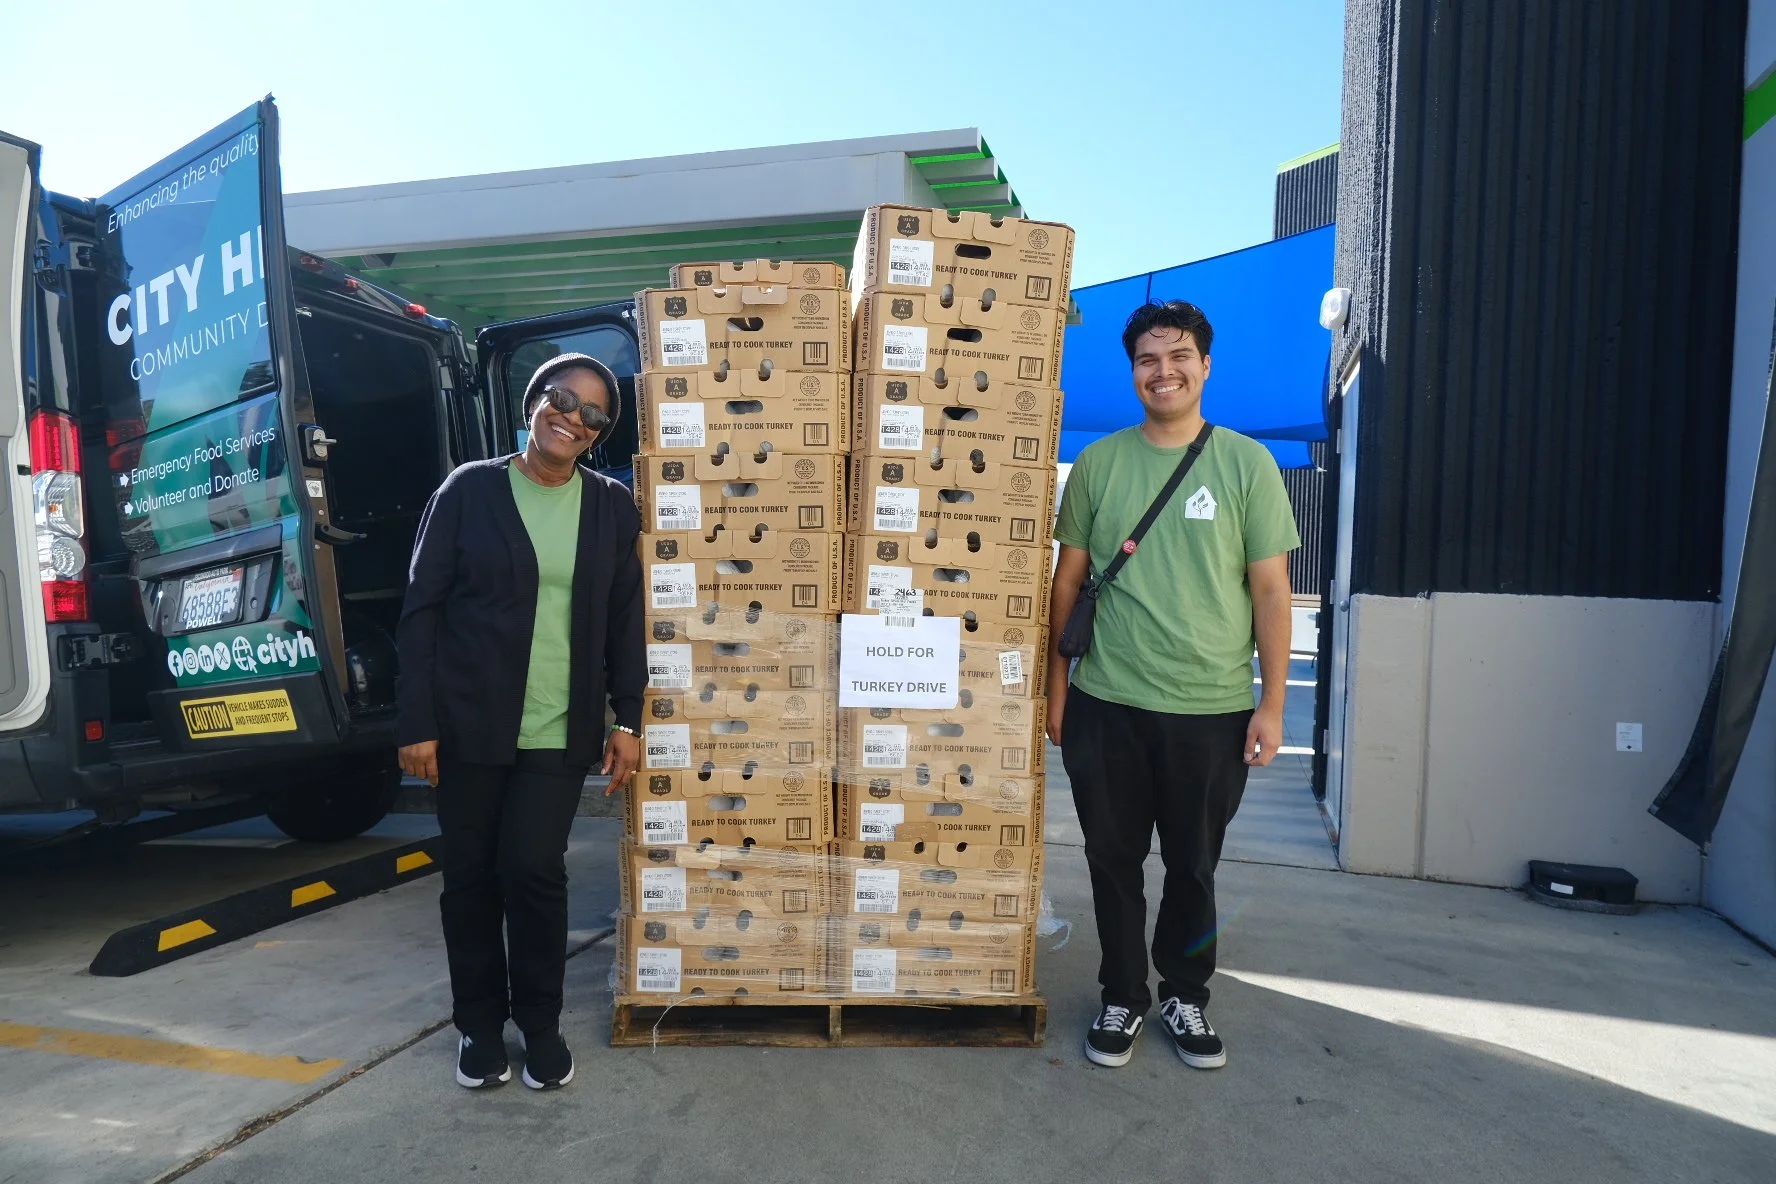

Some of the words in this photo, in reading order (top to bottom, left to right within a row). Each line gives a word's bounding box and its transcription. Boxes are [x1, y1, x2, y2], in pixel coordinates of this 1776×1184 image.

[107, 180, 179, 234] Enhancing
[183, 167, 206, 190] the
[210, 132, 259, 176] quality
[935, 264, 957, 274] READY
[959, 266, 969, 274] TO
[970, 267, 989, 277] COOK
[990, 270, 1018, 281] TURKEY
[107, 254, 205, 346] CITY
[130, 308, 250, 380] COMMUNITY
[710, 341, 730, 349] READY
[929, 348, 950, 357] READY
[951, 348, 960, 356] TO
[962, 349, 981, 358] COOK
[983, 352, 1010, 362] TURKEY
[924, 428, 945, 436] READY
[957, 430, 977, 438] COOK
[978, 432, 1005, 441] TURKEY
[131, 454, 192, 485] Emergency
[194, 439, 223, 465] Food
[225, 427, 275, 455] Services
[135, 487, 187, 514] Volunteer
[189, 477, 212, 498] and
[215, 468, 259, 493] Donate
[704, 506, 726, 514] READY
[728, 506, 737, 514] TO
[919, 510, 940, 518] READY
[942, 511, 951, 520] TO
[953, 512, 973, 521] COOK
[974, 514, 1002, 524] TURKEY
[755, 583, 783, 591] TURKEY
[972, 593, 998, 601] TURKEY
[186, 615, 222, 629] POWELL
[866, 646, 903, 658] HOLD
[907, 647, 934, 658] FOR
[752, 665, 780, 673] TURKEY
[968, 670, 994, 678] TURKEY
[852, 680, 903, 693] TURKEY
[907, 681, 947, 693] DRIVE
[227, 701, 249, 713] VEHICLE
[249, 699, 266, 710] MAKES
[267, 697, 288, 709] SUDDEN
[187, 704, 231, 732] CAUTION
[235, 716, 246, 725] AND
[246, 713, 271, 724] FREQUENT
[271, 711, 289, 722] STOPS
[694, 742, 716, 750] READY
[909, 744, 932, 752] READY
[945, 745, 964, 753] COOK
[966, 745, 992, 753] TURKEY
[717, 818, 726, 826] TO
[727, 818, 747, 826] COOK
[964, 824, 991, 832] TURKEY
[689, 886, 712, 894] READY
[716, 887, 725, 895] TO
[726, 889, 745, 897] COOK
[937, 892, 957, 900] COOK
[959, 892, 985, 901] TURKEY
[684, 968, 707, 976] READY
[934, 969, 952, 977] COOK
[954, 969, 981, 977] TURKEY
